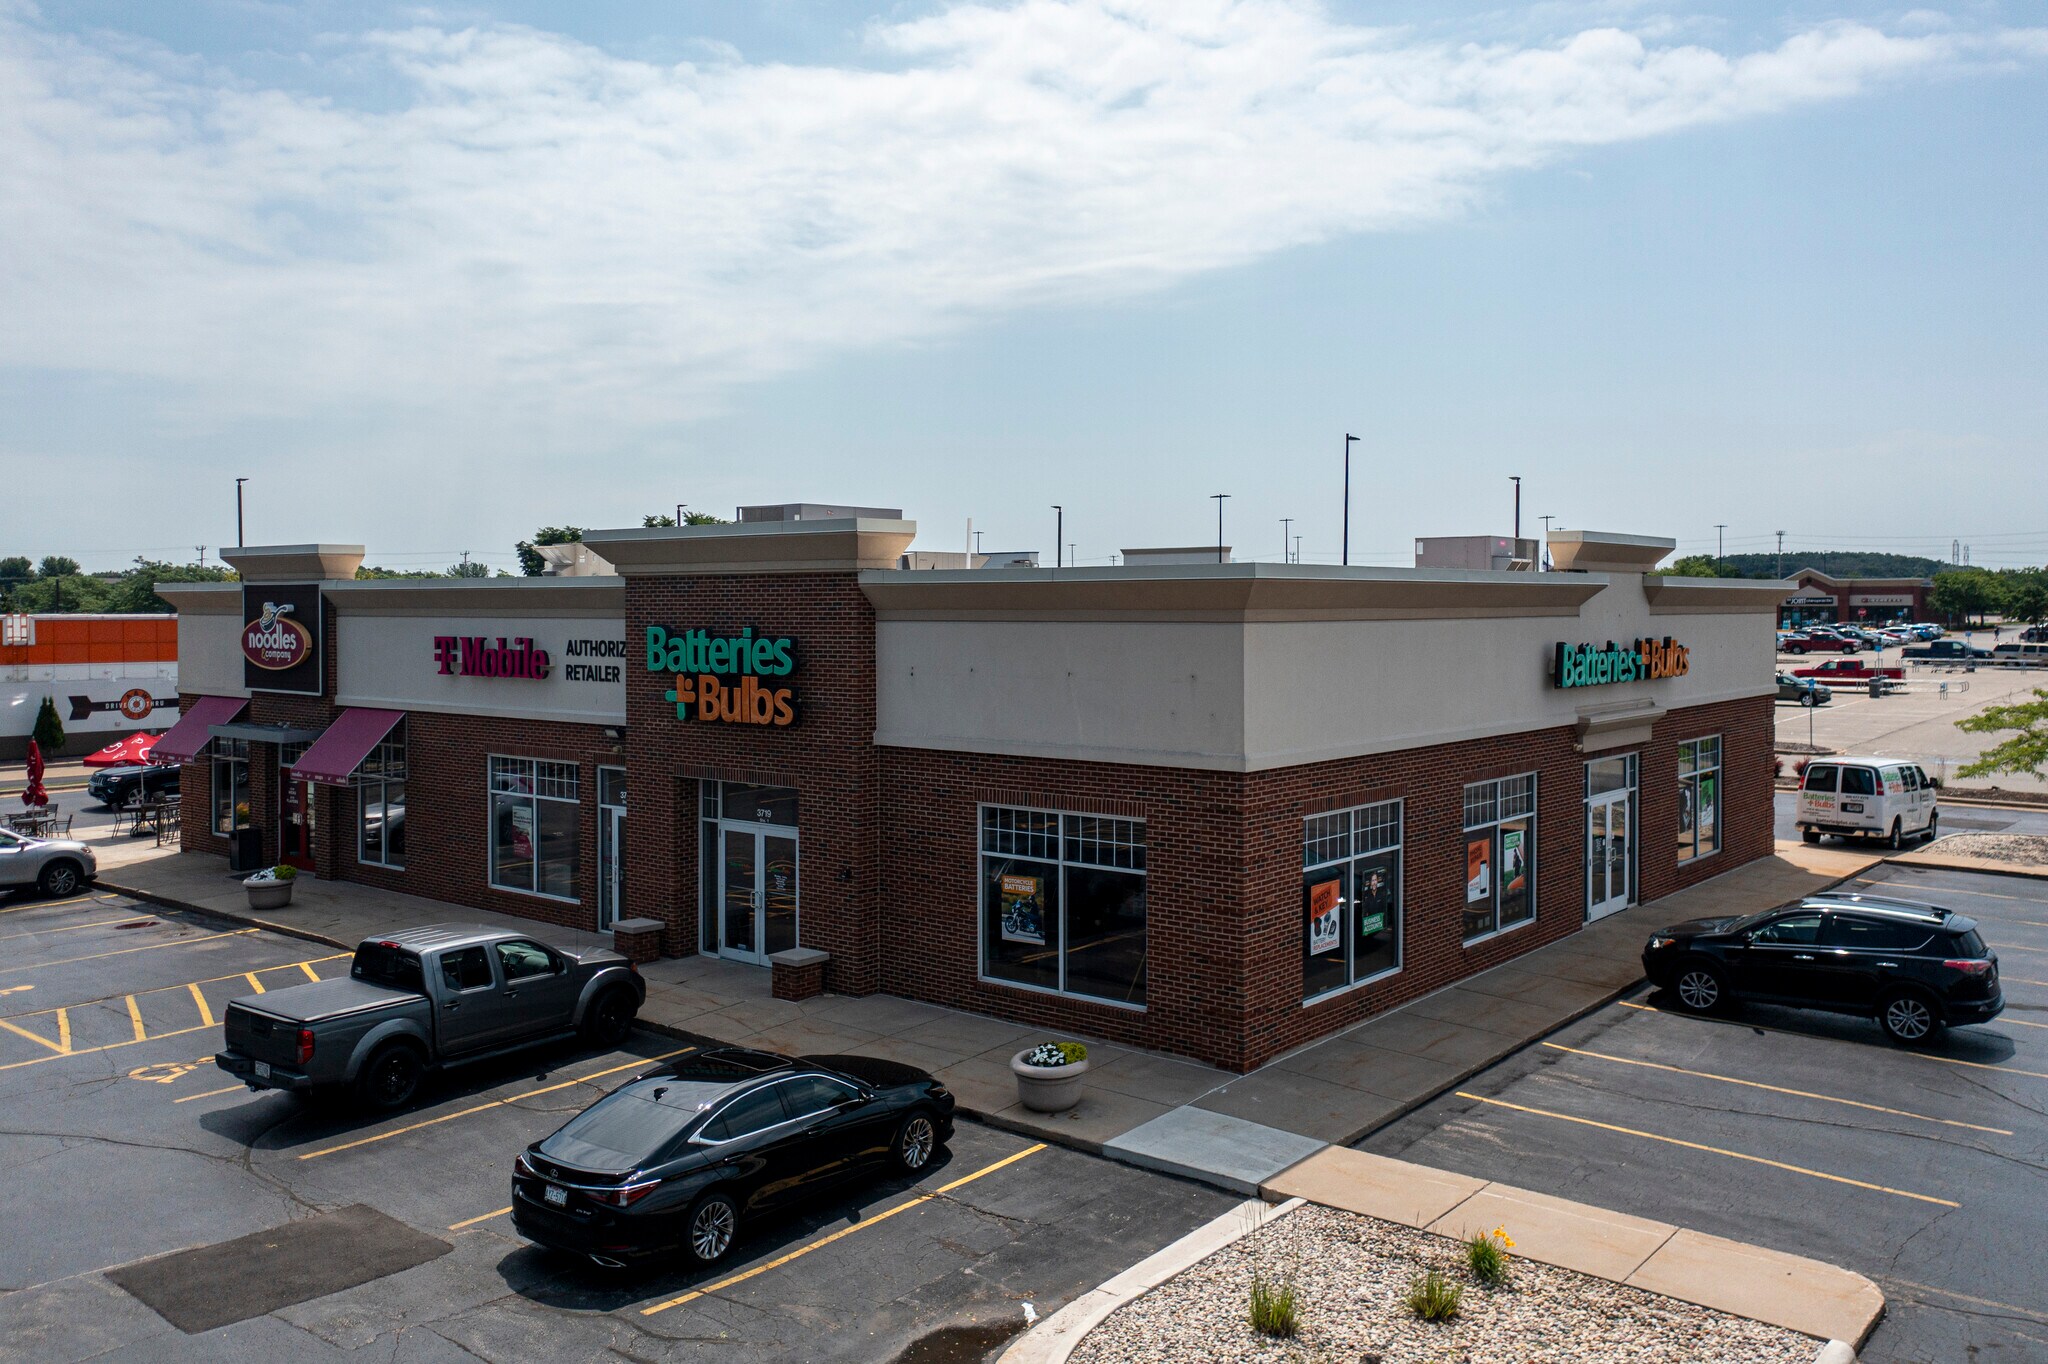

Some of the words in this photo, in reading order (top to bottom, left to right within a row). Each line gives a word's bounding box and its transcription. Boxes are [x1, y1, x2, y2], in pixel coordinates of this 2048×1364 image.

[248, 623, 297, 650] noodles
[646, 626, 793, 676] Batteries
[566, 664, 620, 683] RETAILER
[1562, 643, 1635, 688] Batteries
[105, 702, 128, 710] DRIVE
[146, 700, 164, 708] THRU
[756, 808, 772, 818] 3719
[1004, 883, 1034, 892] BATTERIES
[1313, 888, 1331, 906] WATCH
[1318, 901, 1328, 911] KEY
